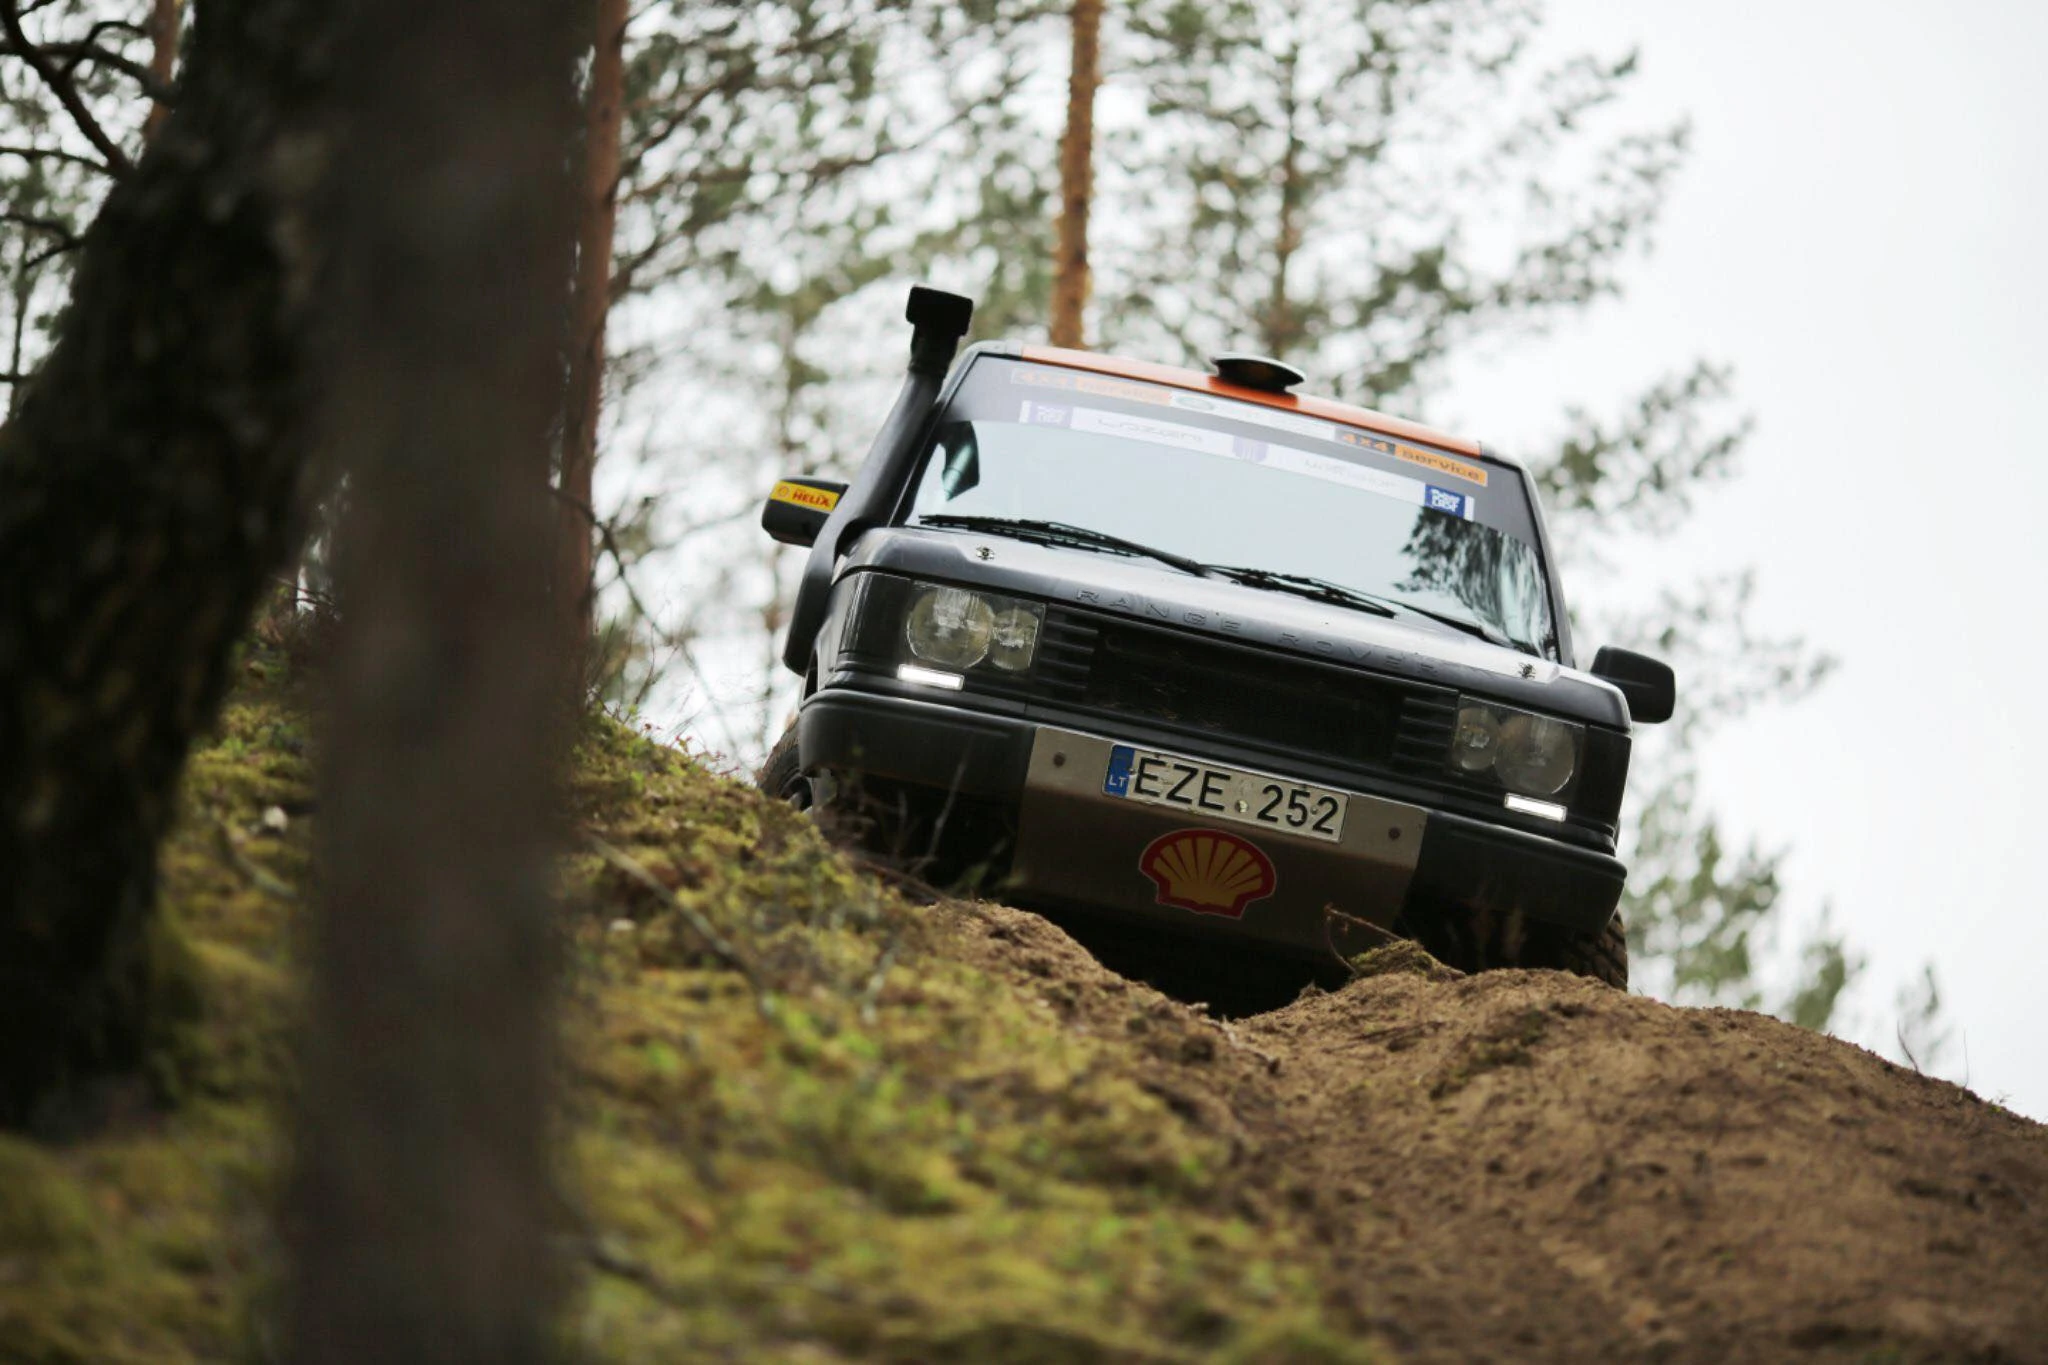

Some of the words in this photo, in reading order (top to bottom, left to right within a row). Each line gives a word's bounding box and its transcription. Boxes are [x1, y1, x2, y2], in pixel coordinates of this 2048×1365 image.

[793, 491, 830, 507] HELIX
[1076, 590, 1241, 632] RANGE
[1279, 633, 1437, 676] ROVER
[1109, 774, 1126, 788] LT
[1135, 758, 1231, 811] EZE
[1257, 784, 1339, 834] 252
